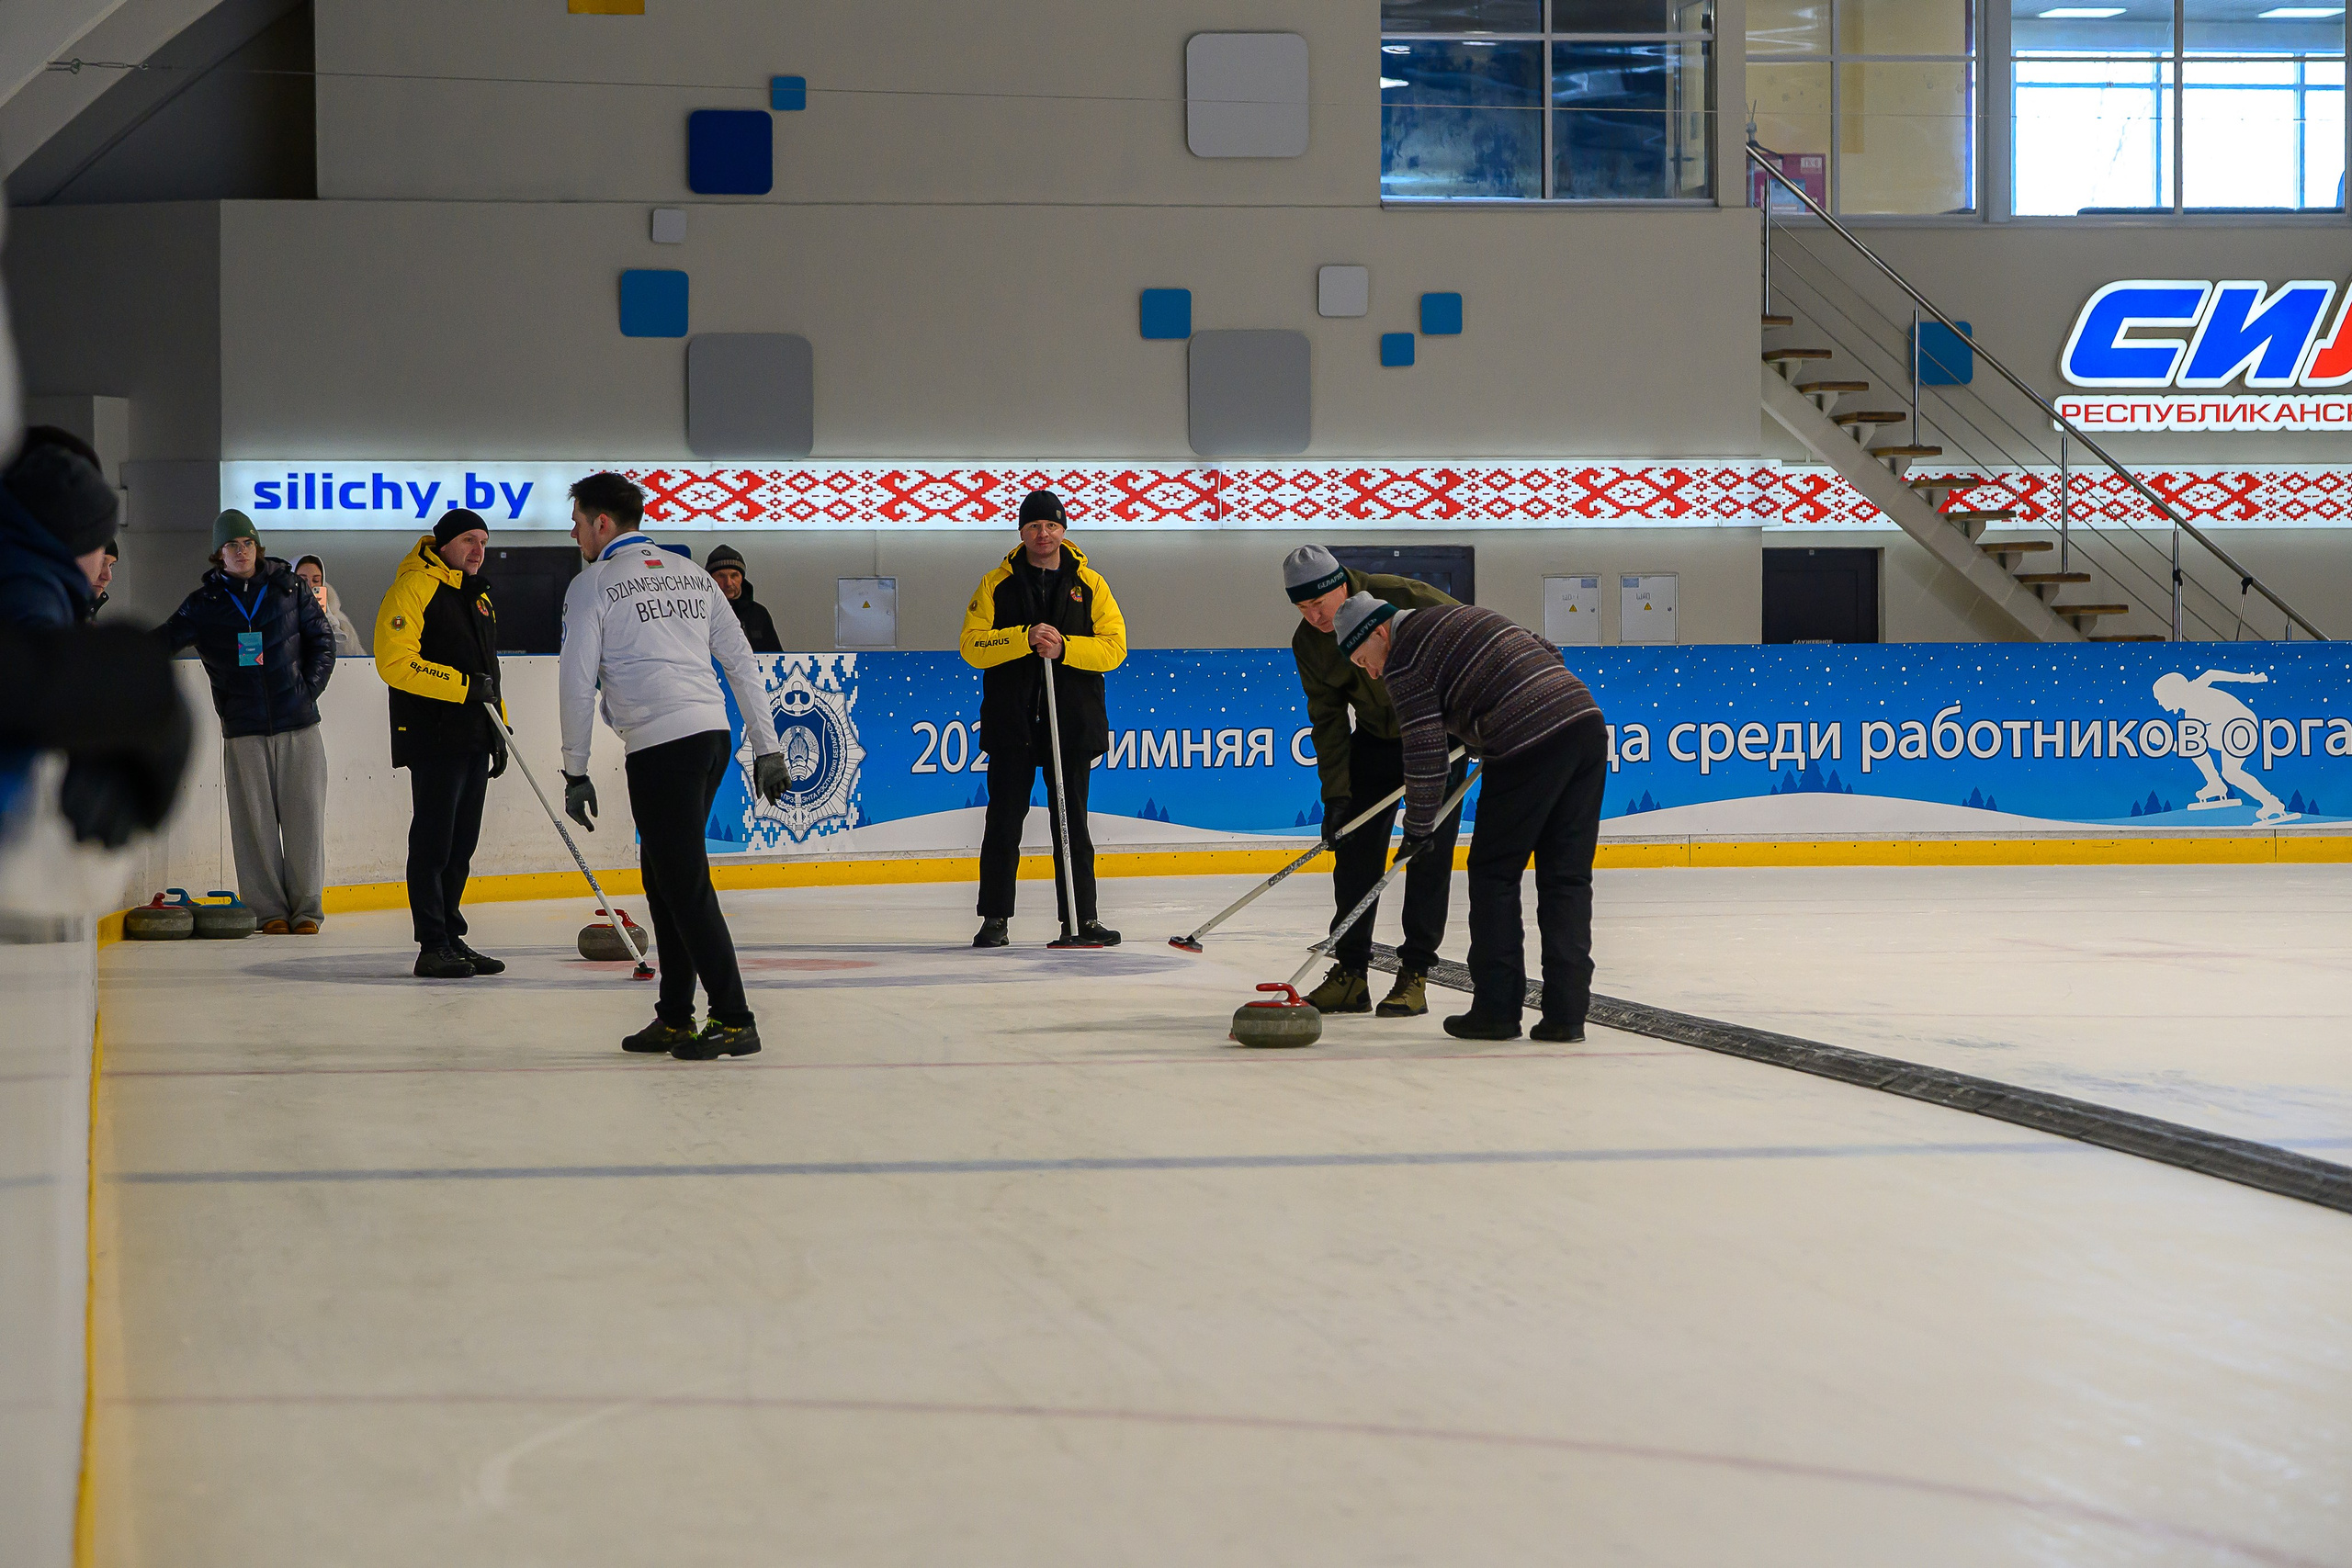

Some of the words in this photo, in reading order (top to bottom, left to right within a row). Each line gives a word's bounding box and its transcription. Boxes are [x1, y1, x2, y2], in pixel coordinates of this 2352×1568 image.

[2061, 402, 2352, 423] РЕСПУБЛИКАНС
[254, 471, 535, 519] silichy.by
[605, 575, 714, 604] DZIAMESHCHANKA
[635, 598, 707, 623] BELARUS
[911, 720, 989, 773] 202
[1667, 721, 1842, 775] среди
[1860, 704, 2209, 773] работников
[2222, 717, 2352, 771] орга
